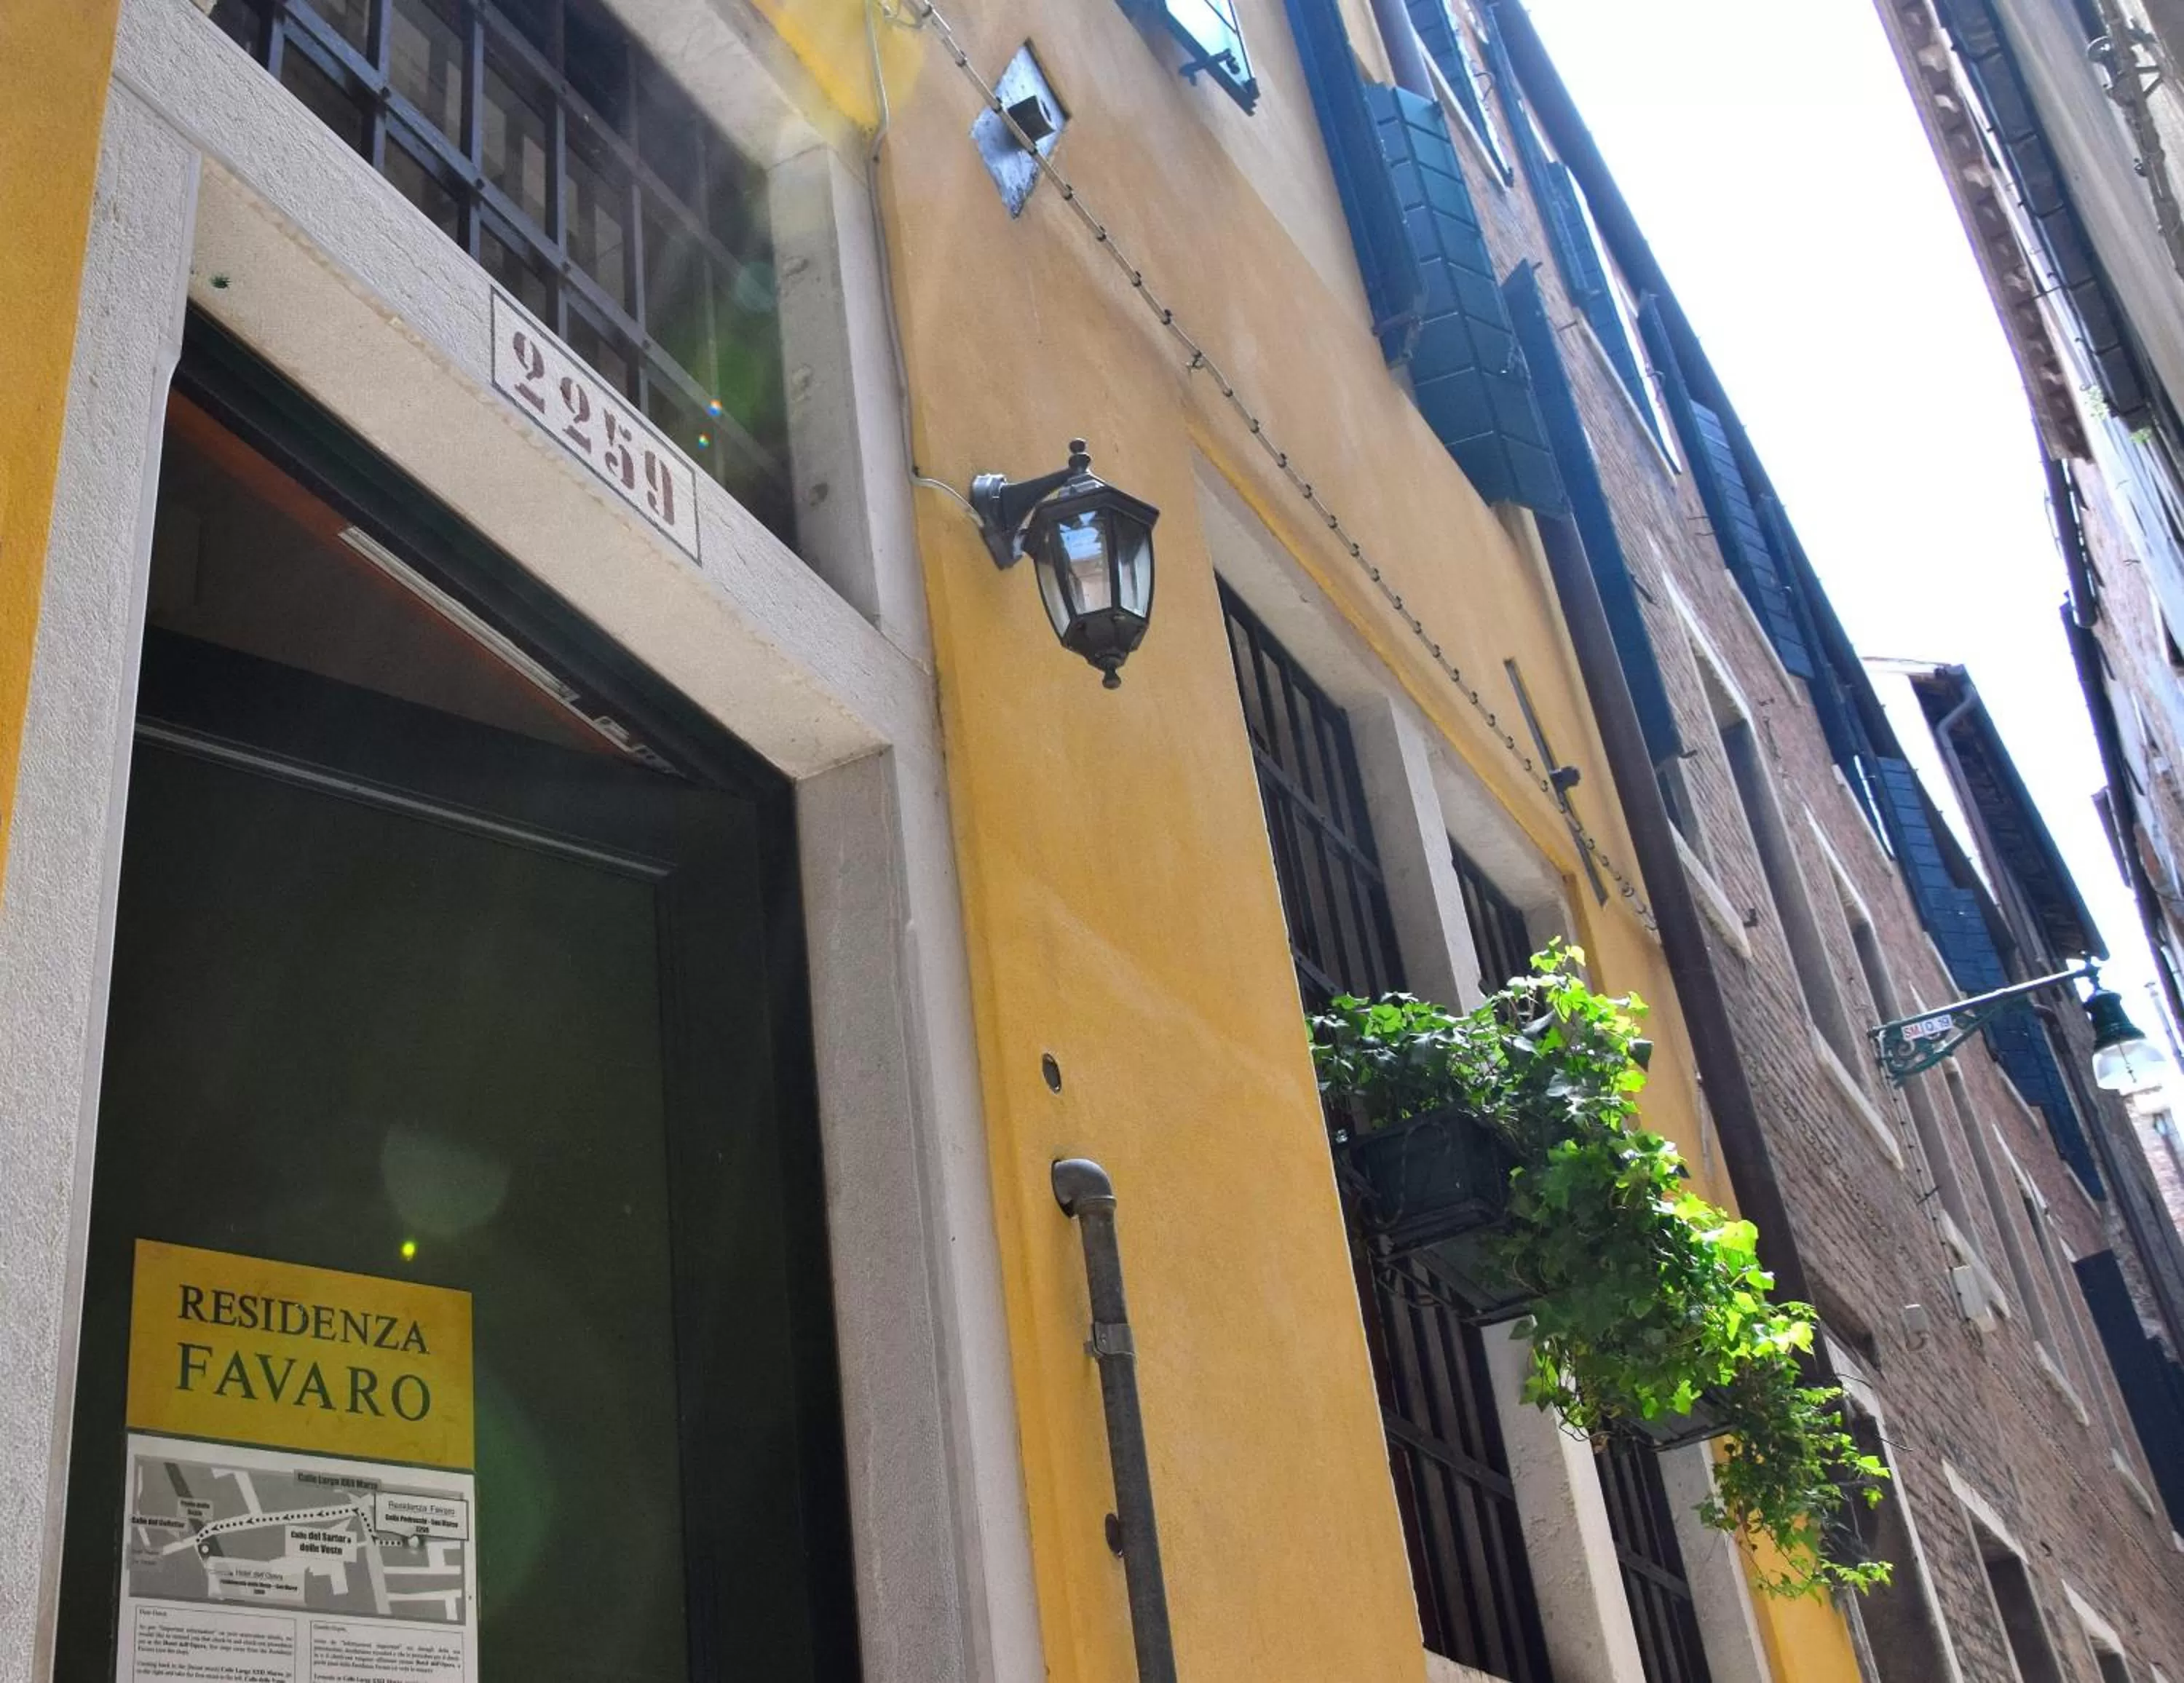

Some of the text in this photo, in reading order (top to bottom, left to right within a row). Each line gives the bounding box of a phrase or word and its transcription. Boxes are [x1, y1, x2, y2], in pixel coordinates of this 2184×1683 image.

[513, 331, 675, 526] 2259
[178, 1283, 431, 1355] RESIDENZA
[175, 1342, 432, 1422] FAVARO
[308, 1531, 321, 1540] del
[322, 1532, 345, 1543] Sartor
